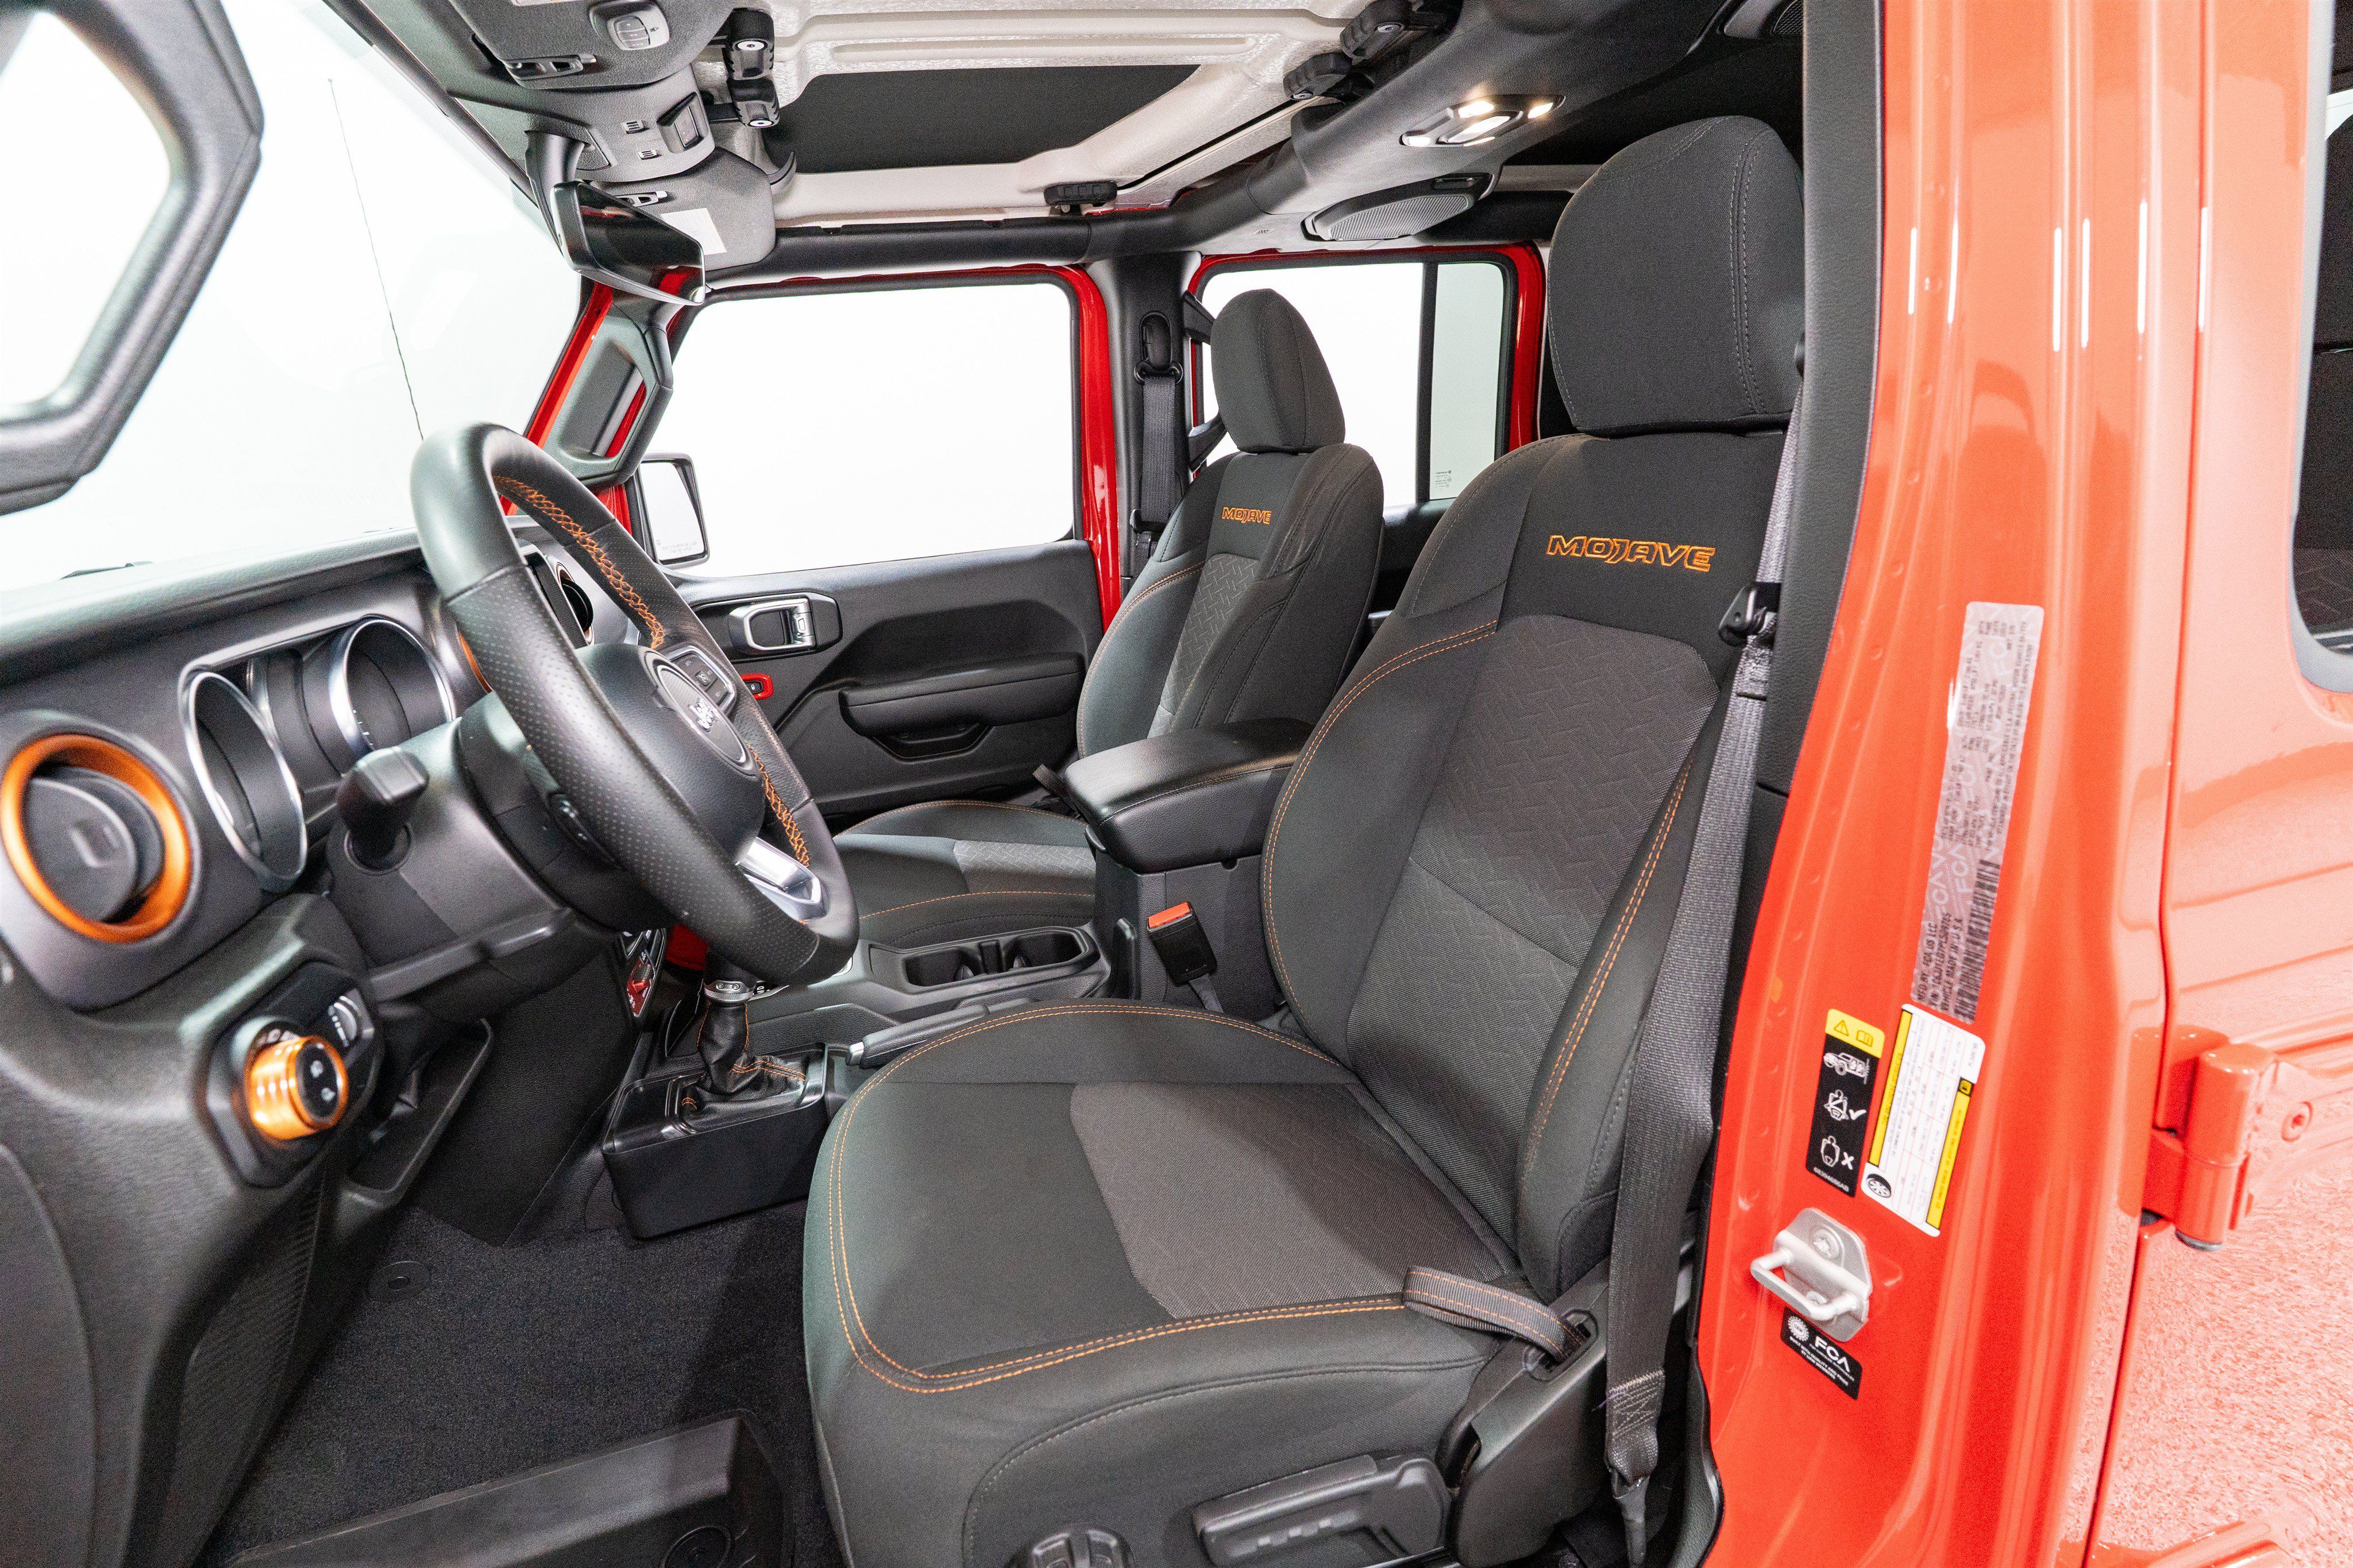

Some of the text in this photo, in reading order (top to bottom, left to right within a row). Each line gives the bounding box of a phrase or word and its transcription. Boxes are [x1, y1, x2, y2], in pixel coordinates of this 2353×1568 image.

[1222, 507, 1271, 524] MOJAVE
[1546, 535, 1715, 572] MOJAVE
[1815, 1337, 1850, 1372] FCA
